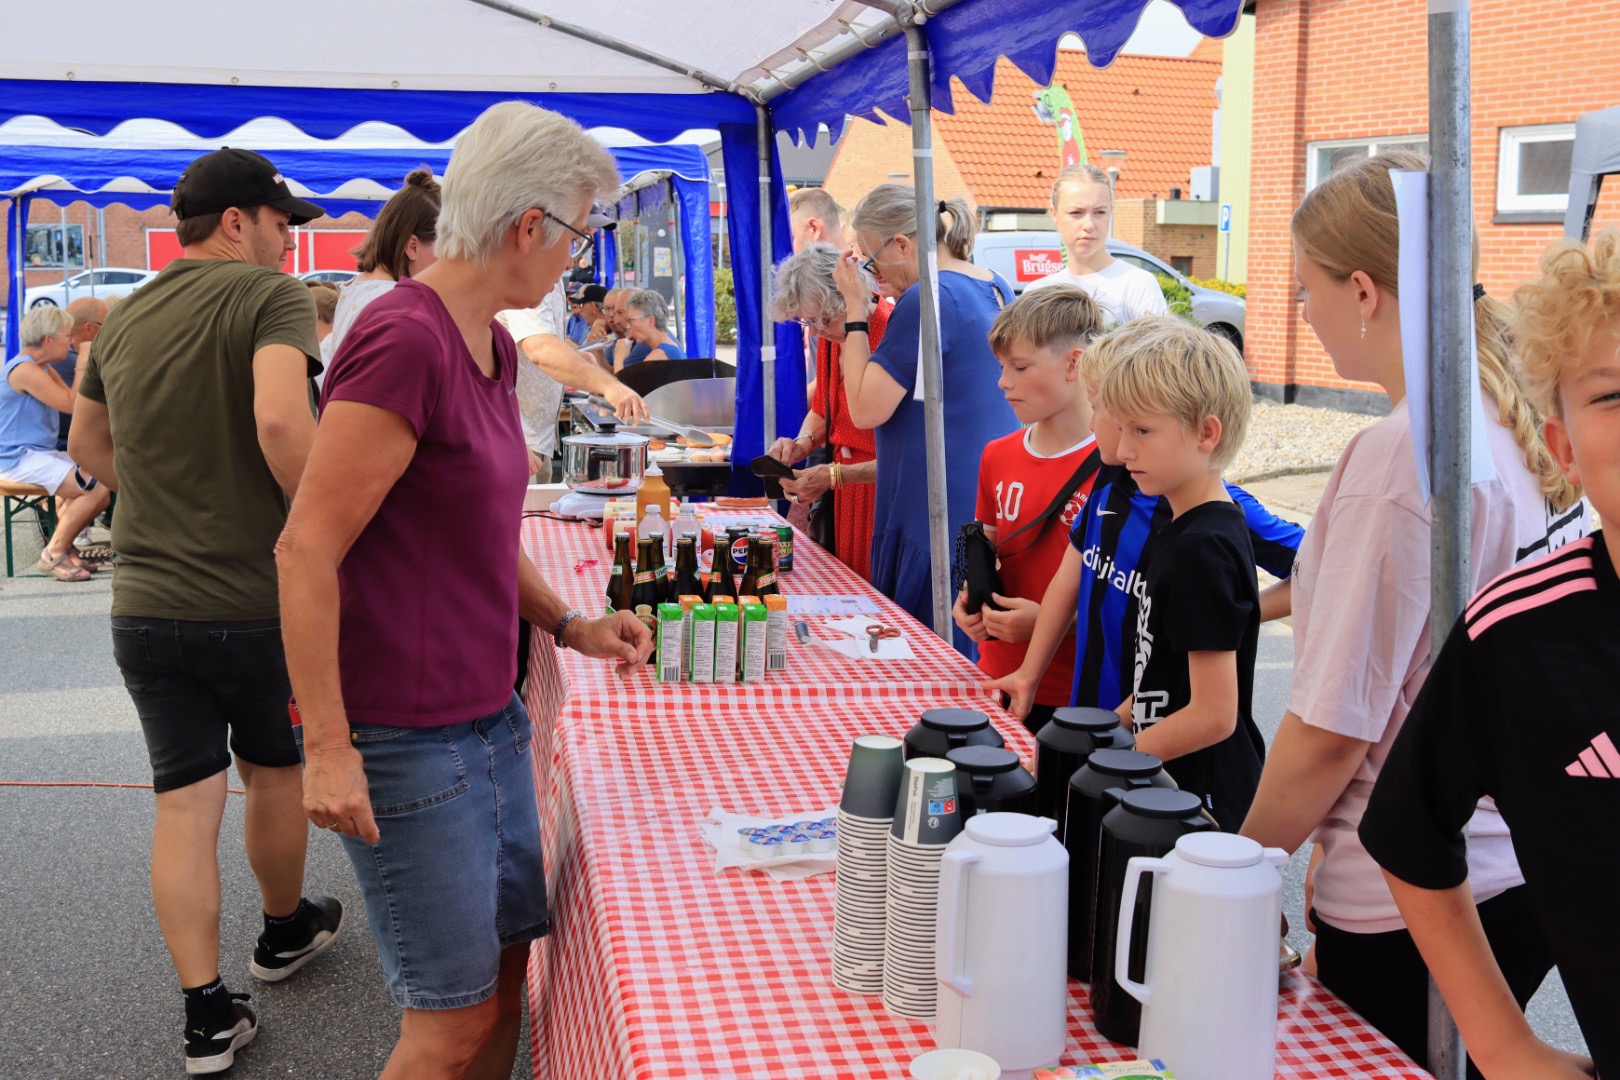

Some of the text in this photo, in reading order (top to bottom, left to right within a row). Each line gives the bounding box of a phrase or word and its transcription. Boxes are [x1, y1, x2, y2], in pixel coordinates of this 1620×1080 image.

[1222, 206, 1229, 229] P
[1023, 260, 1064, 275] Brugse
[996, 481, 1024, 521] 10
